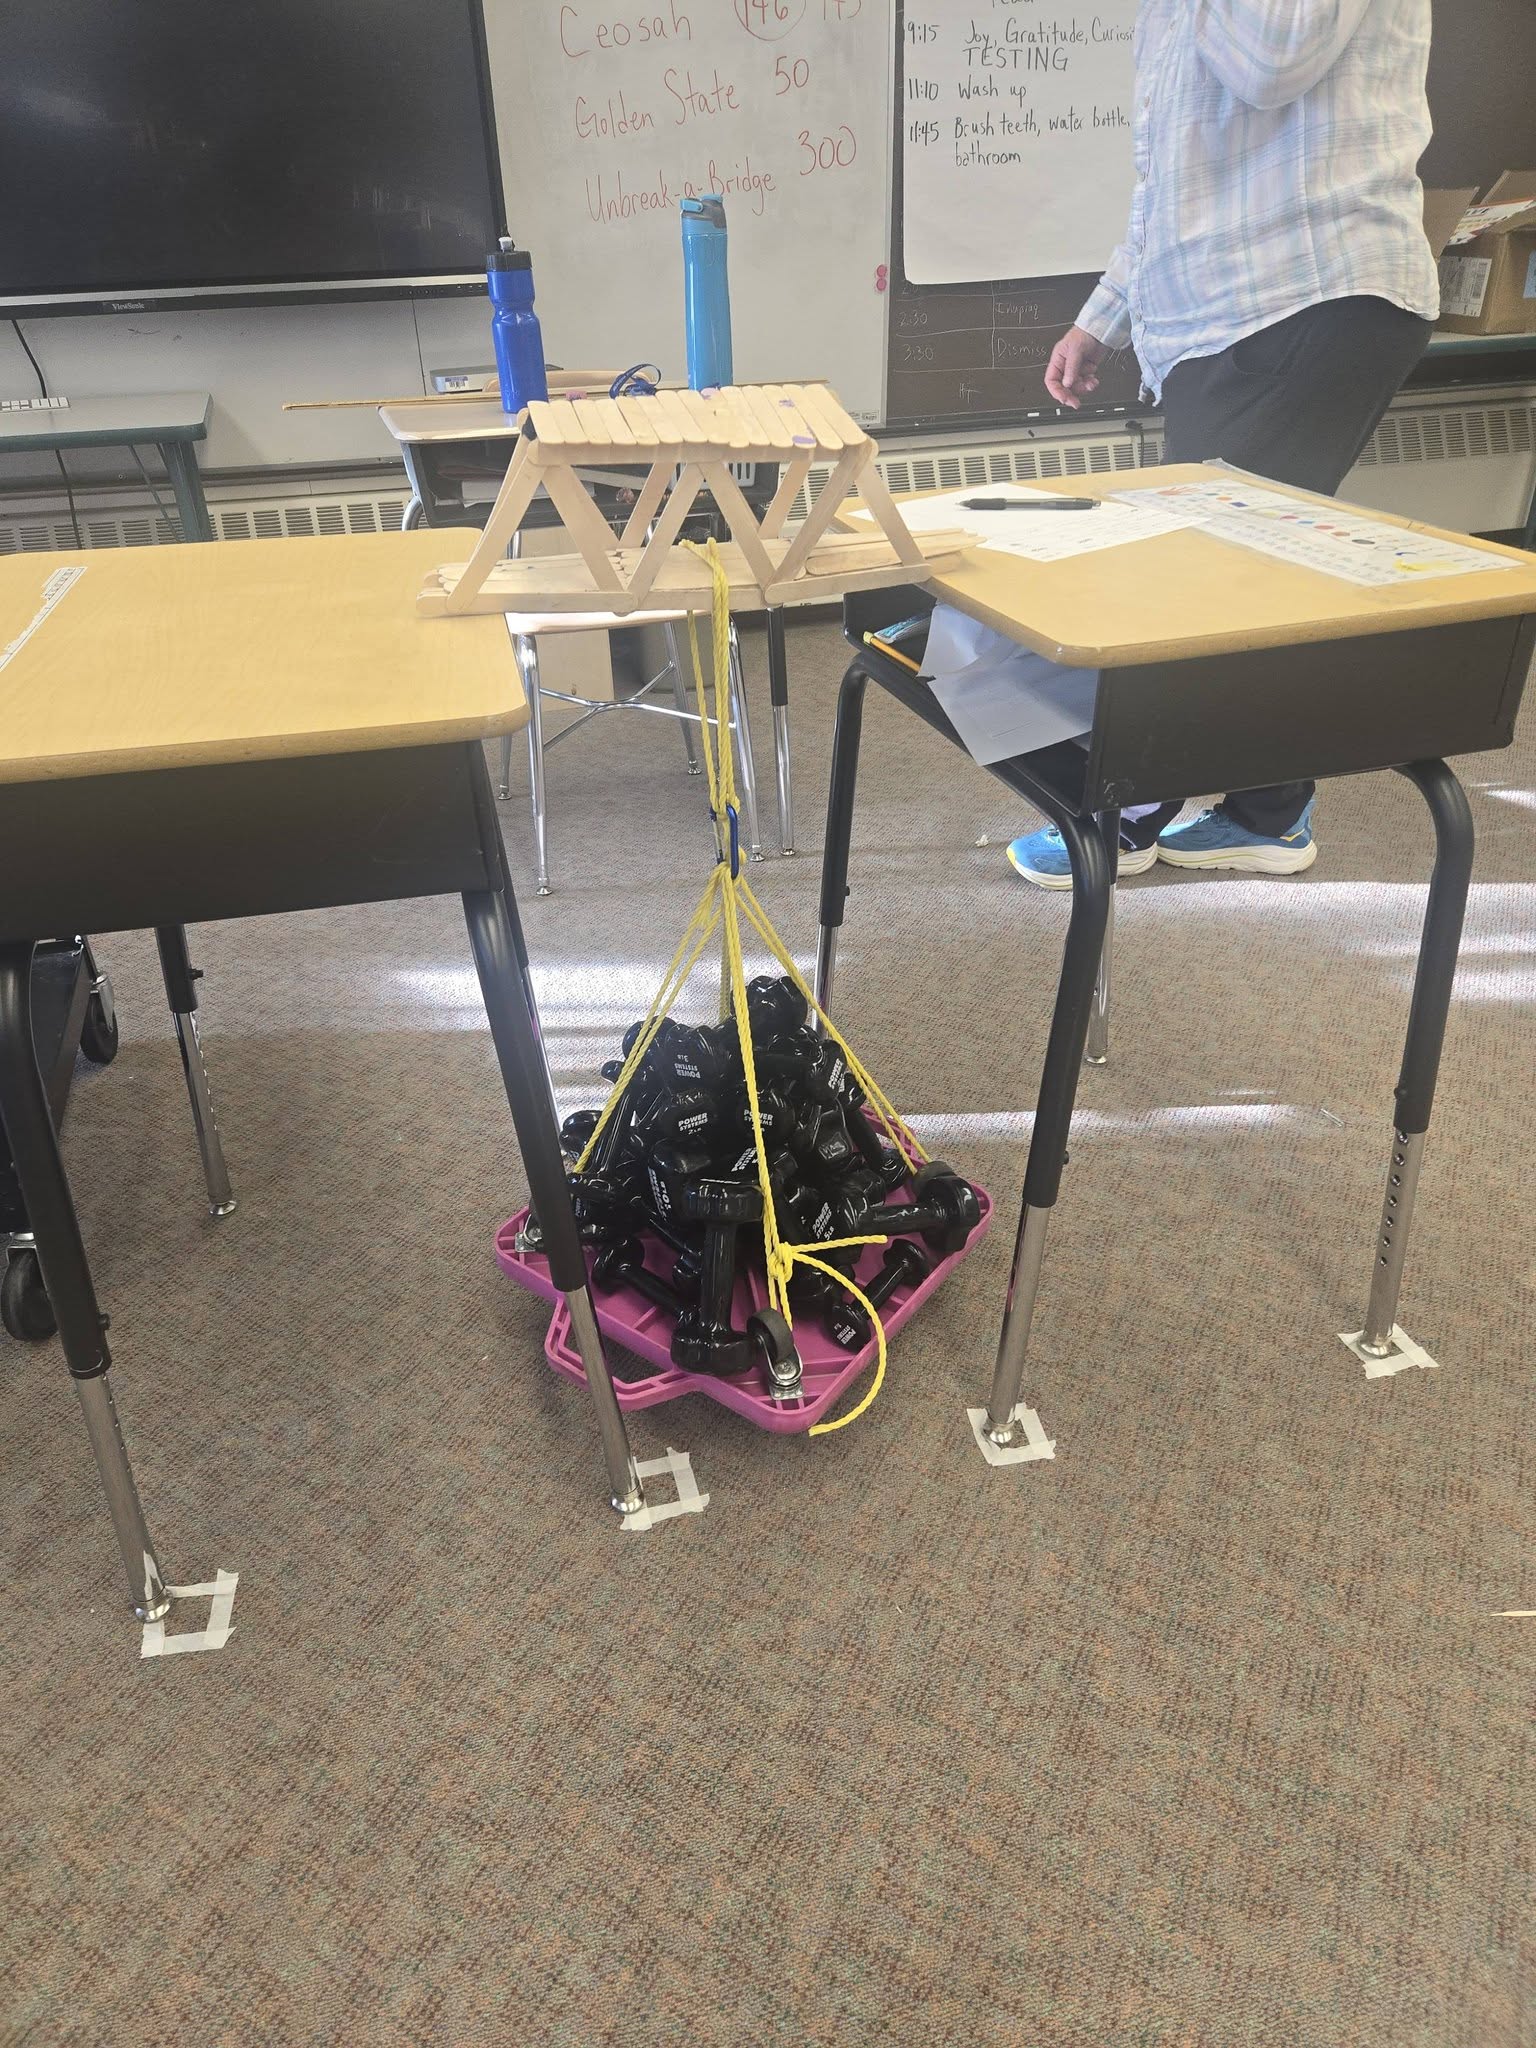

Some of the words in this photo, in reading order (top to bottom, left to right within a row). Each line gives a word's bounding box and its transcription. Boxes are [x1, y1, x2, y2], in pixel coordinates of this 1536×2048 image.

[907, 21, 940, 45] 9:15
[965, 19, 998, 49] Joy,
[1005, 16, 1088, 46] Gratitude,
[962, 46, 1069, 72] TESTING
[575, 90, 655, 138] Golden
[664, 69, 740, 125] State
[775, 55, 810, 96] 50
[908, 78, 939, 101] 11:10
[958, 74, 999, 99] Wash
[1010, 85, 1027, 108] up
[909, 120, 940, 146] 11:45
[954, 111, 995, 138] Brush
[1000, 108, 1041, 137] teeth,
[1049, 105, 1083, 131] water
[798, 125, 858, 175] 300
[955, 140, 1021, 167] bathroom
[678, 1112, 708, 1127] POWER
[679, 1118, 709, 1131] SYSTEMS
